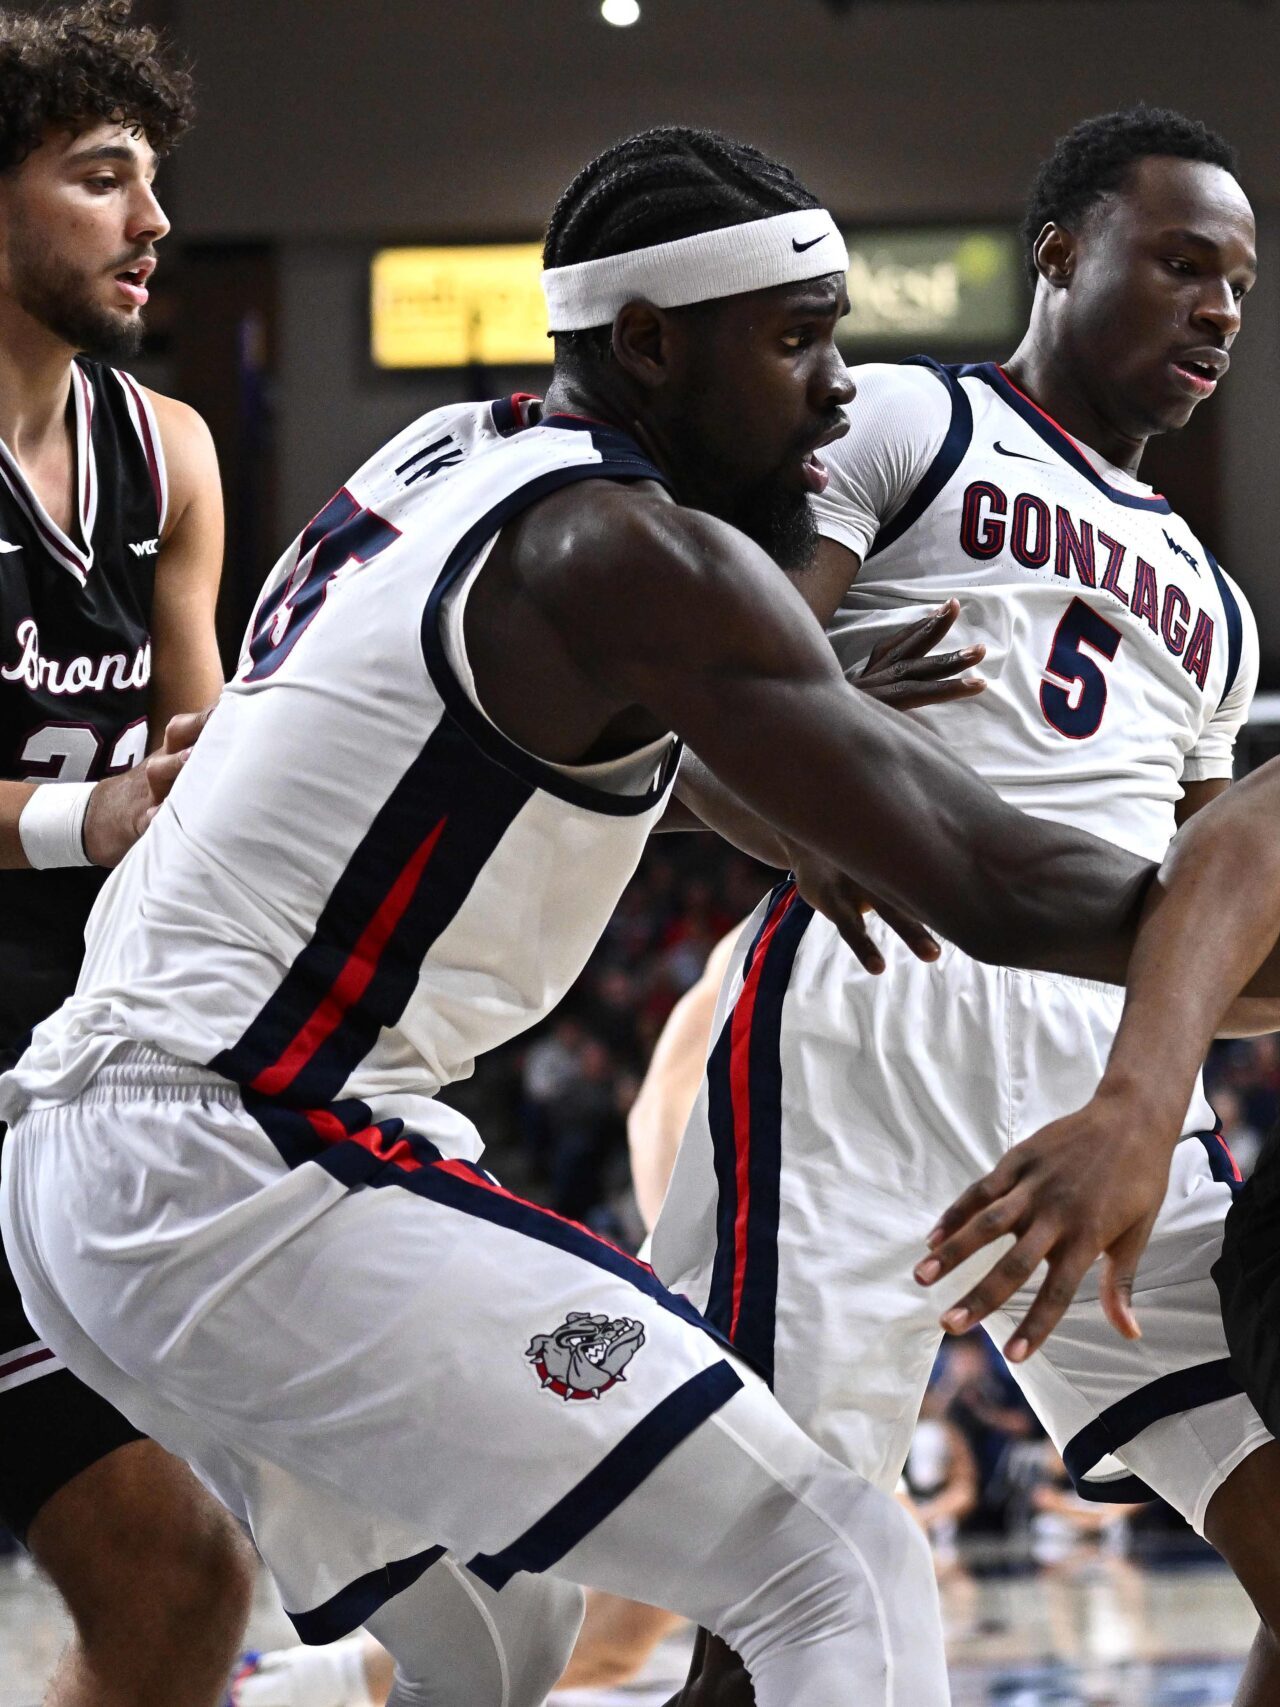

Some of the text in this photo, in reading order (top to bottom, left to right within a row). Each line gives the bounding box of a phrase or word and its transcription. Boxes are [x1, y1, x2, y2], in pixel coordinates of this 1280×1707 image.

[128, 538, 159, 557] WCC
[959, 480, 1214, 692] GONZAGA
[1038, 595, 1123, 740] 5
